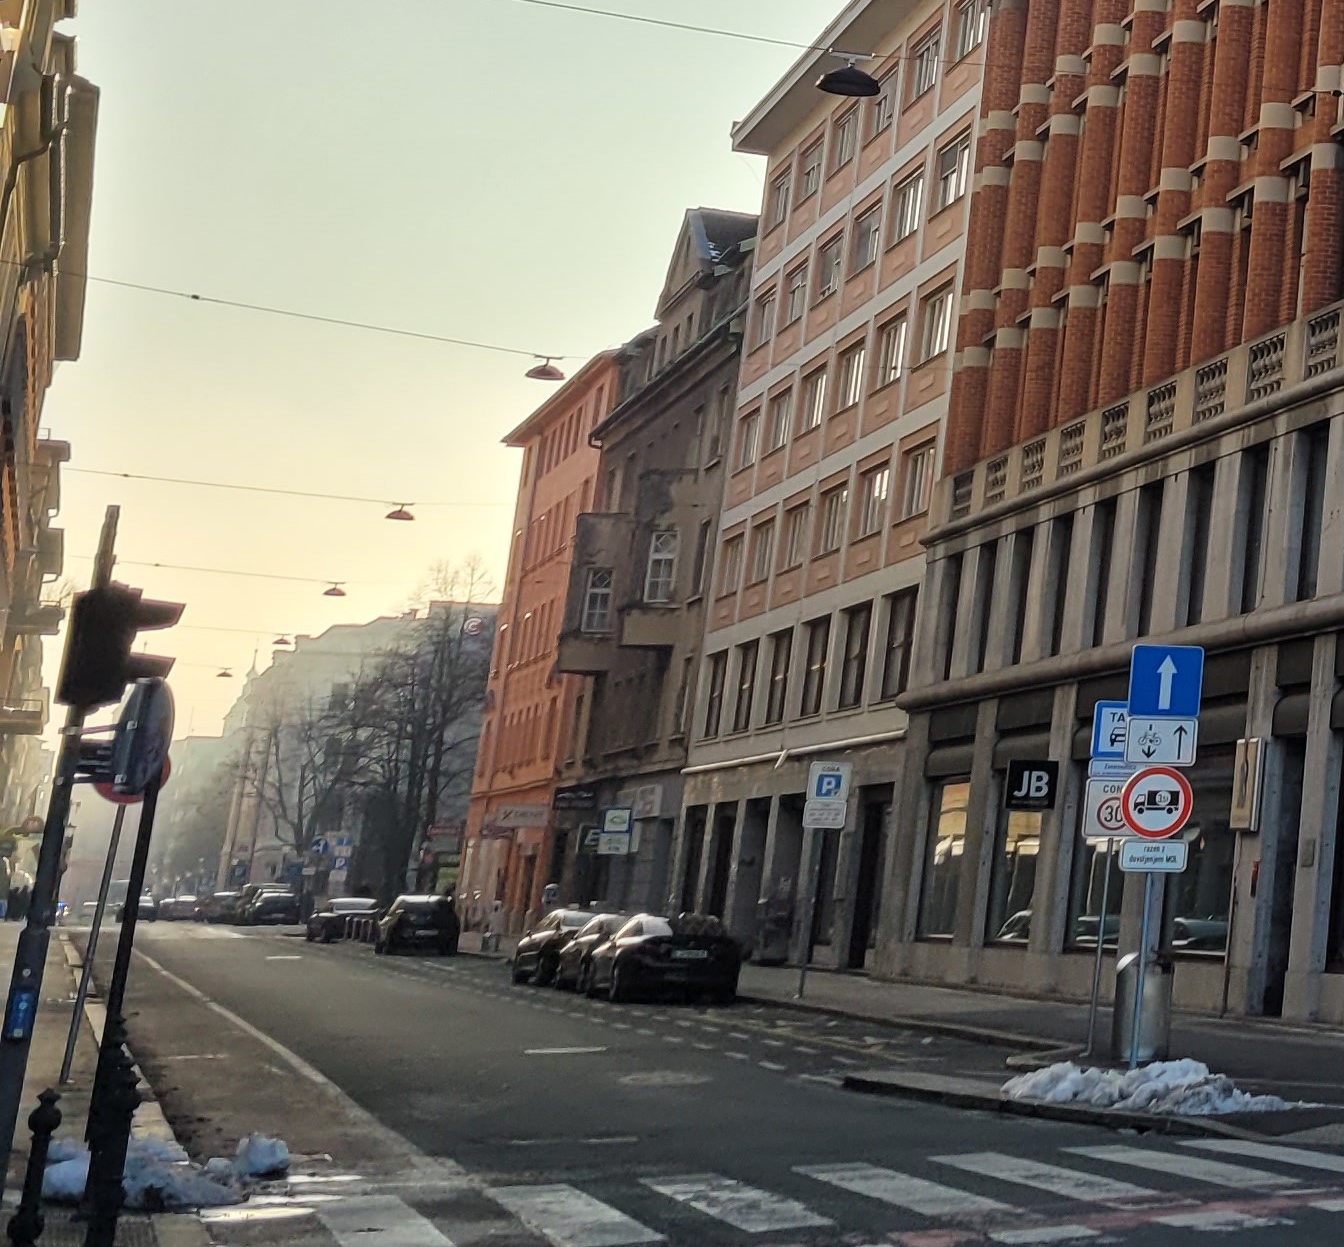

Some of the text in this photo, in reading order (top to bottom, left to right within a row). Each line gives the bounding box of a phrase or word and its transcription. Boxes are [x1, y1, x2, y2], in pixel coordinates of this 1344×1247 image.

[1110, 712, 1126, 723] TA
[1013, 770, 1049, 797] JB
[1103, 784, 1123, 794] CON
[1104, 804, 1123, 823] 30
